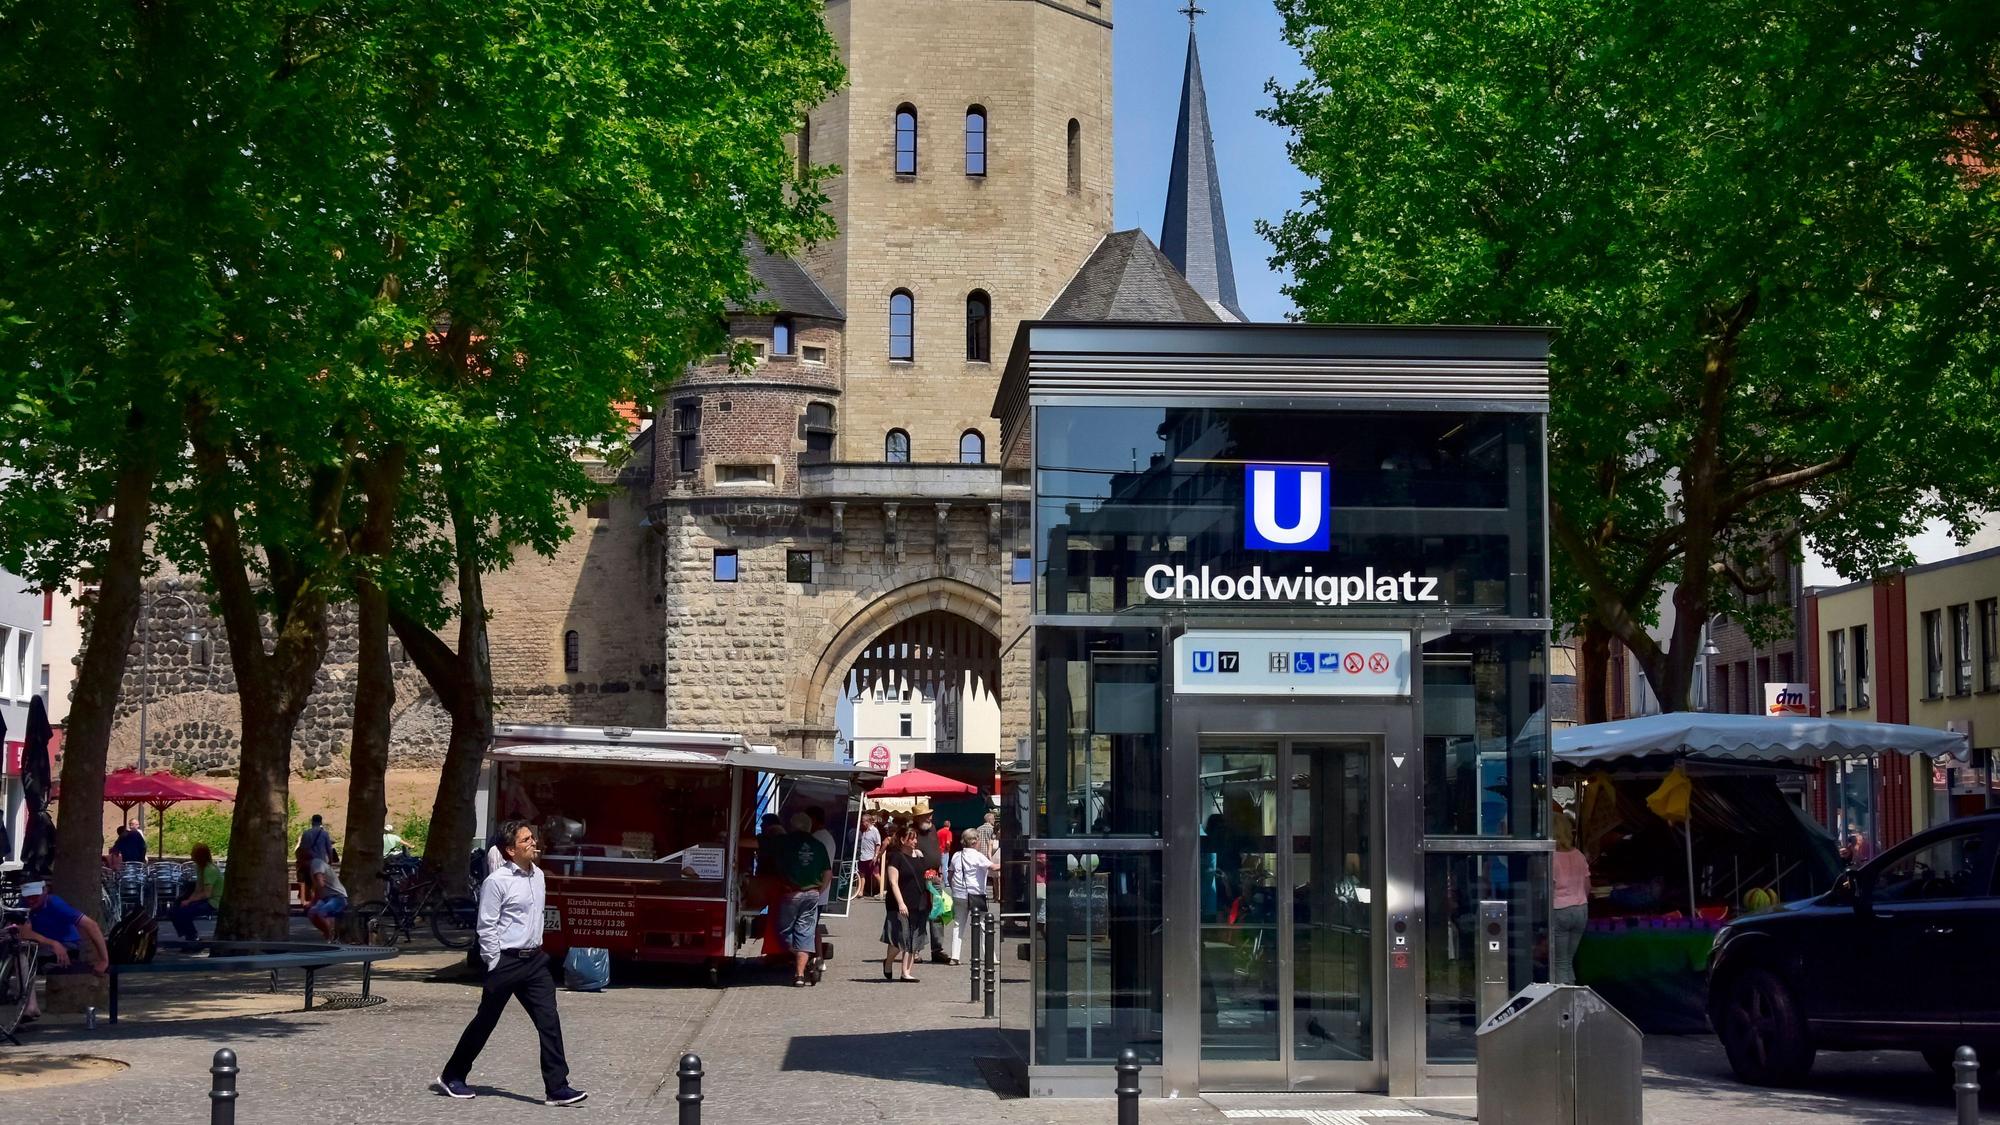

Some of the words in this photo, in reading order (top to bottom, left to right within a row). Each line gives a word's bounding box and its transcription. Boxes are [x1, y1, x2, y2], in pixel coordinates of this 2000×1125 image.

[1253, 470, 1323, 544] U
[1143, 563, 1439, 606] Chlodwigplatz
[1194, 652, 1213, 671] U
[1220, 655, 1238, 670] 17
[1776, 688, 1803, 705] dm
[567, 898, 626, 908] Kirchheimerstr.
[591, 909, 635, 917] Euskirchen
